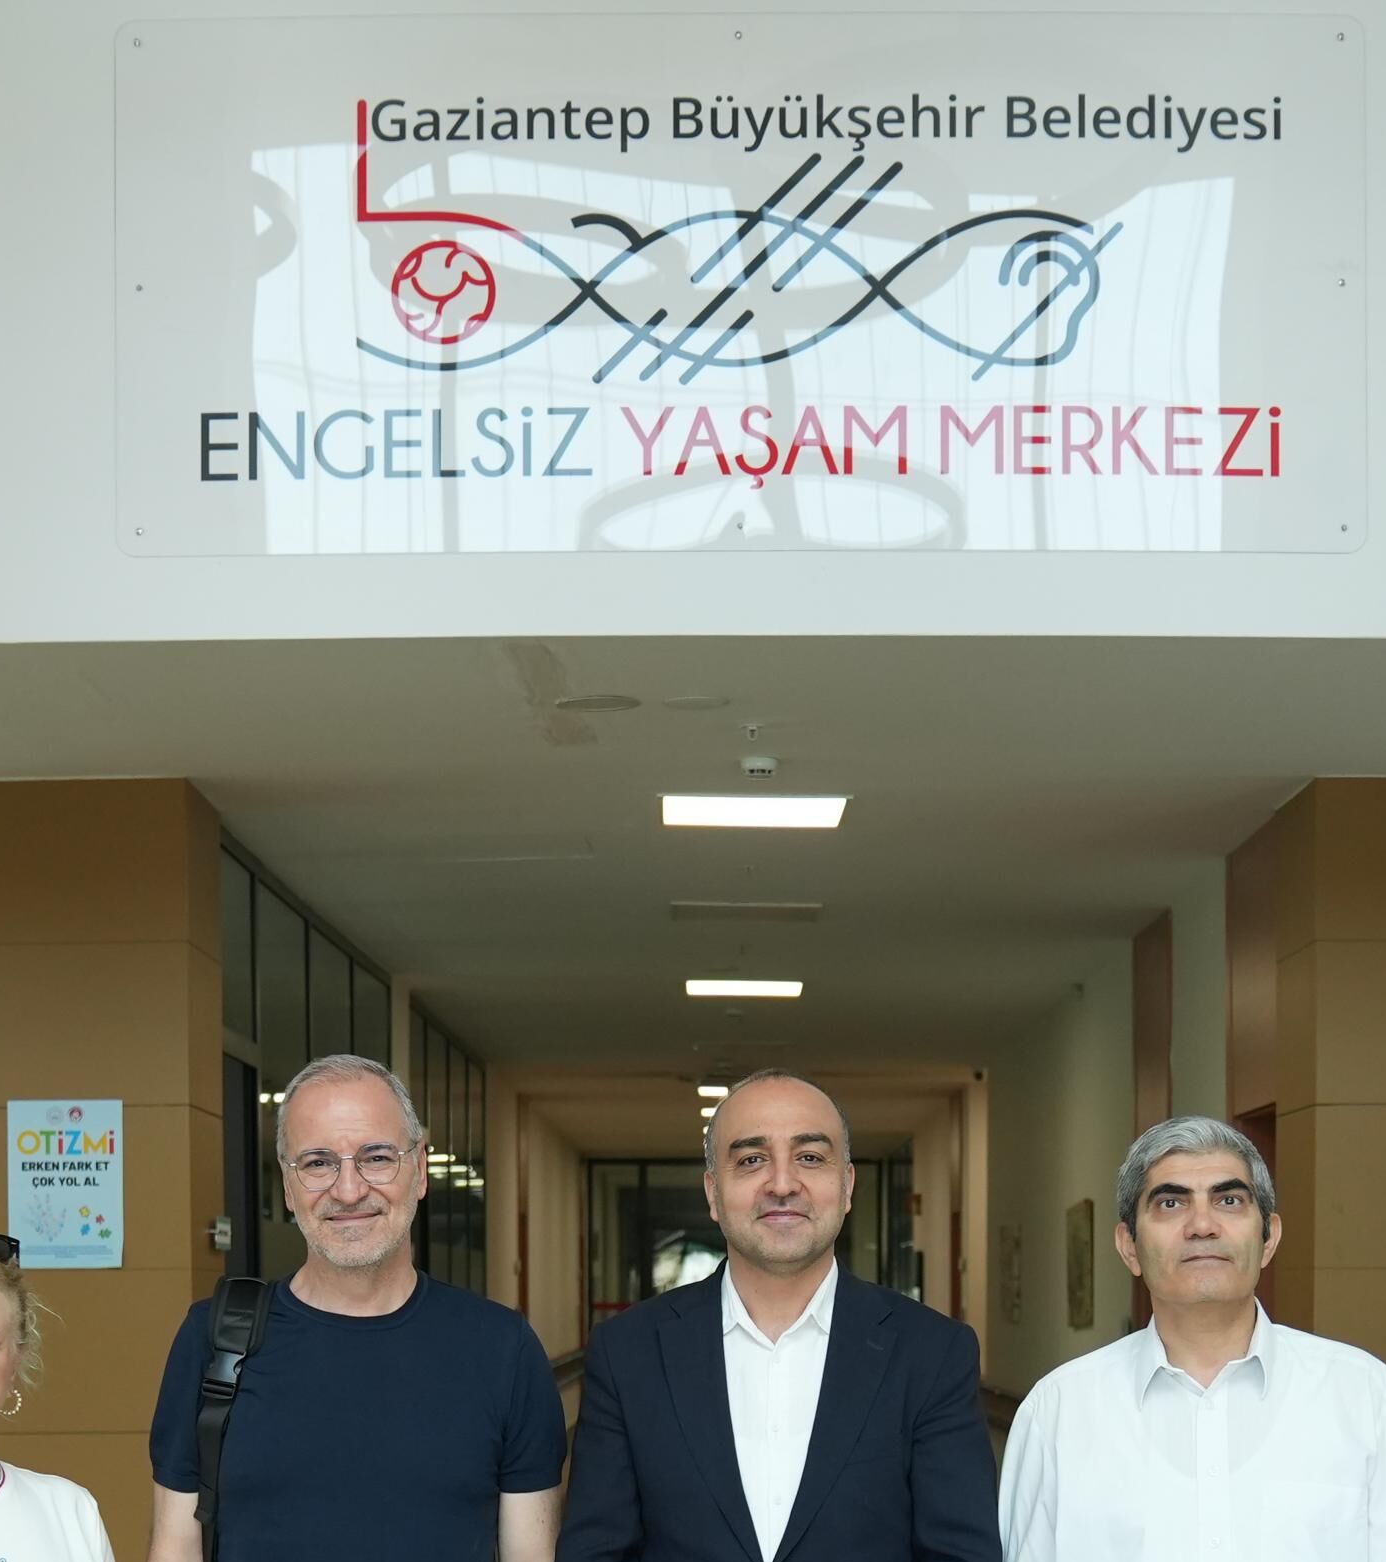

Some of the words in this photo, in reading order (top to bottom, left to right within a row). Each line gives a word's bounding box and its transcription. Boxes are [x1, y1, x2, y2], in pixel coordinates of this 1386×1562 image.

[371, 97, 651, 153] Gaziantep
[672, 94, 985, 153] Büyükşehir
[1006, 94, 1282, 153] Belediyesi
[620, 404, 909, 489] YAŞAM
[21, 1161, 60, 1172] ERKEN
[62, 1161, 92, 1172] FARK
[95, 1161, 110, 1172] ET
[32, 1177, 55, 1189] ÇOK
[58, 1177, 80, 1187] YOL
[83, 1177, 100, 1187] AL
